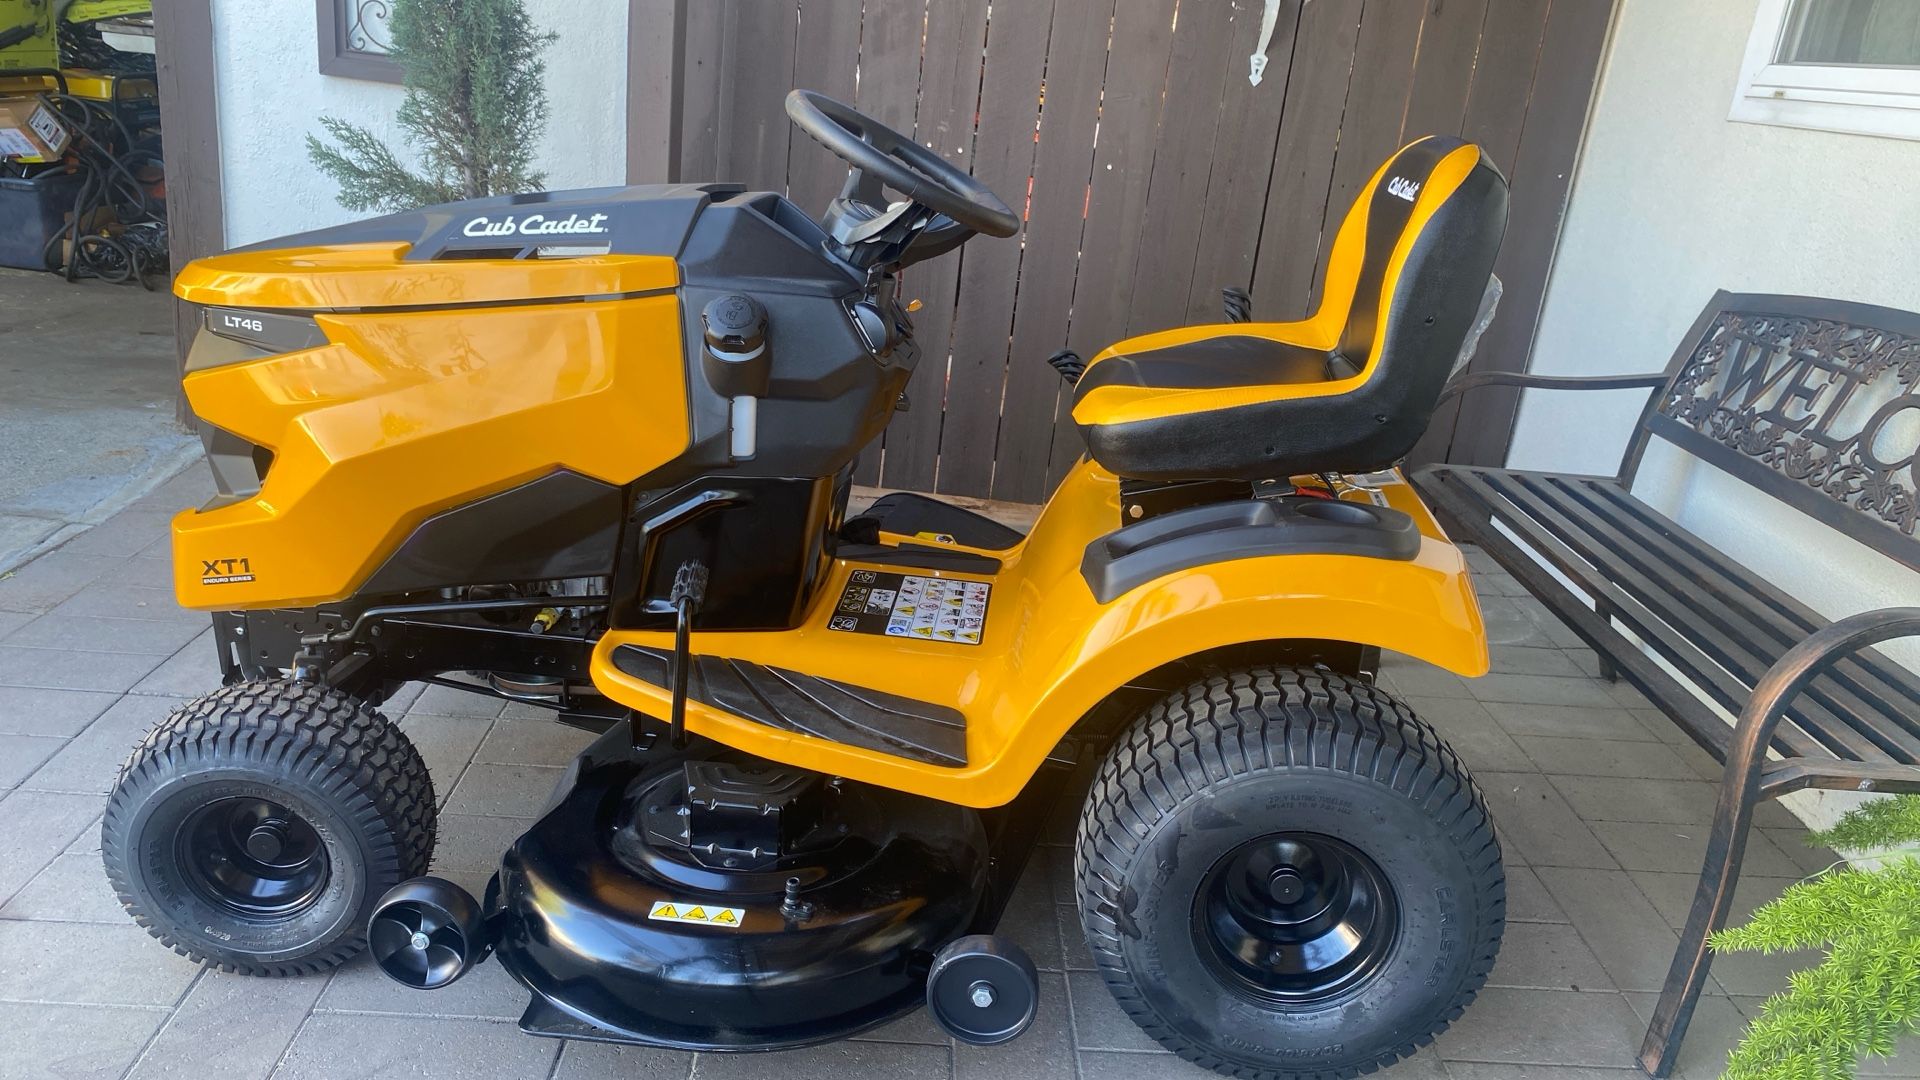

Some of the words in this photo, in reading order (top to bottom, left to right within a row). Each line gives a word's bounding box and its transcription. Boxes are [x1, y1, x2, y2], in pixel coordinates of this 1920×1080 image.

[463, 216, 517, 237] Cub
[519, 213, 609, 235] Cadet
[224, 315, 263, 332] LT46
[1716, 334, 1920, 494] WELC
[201, 558, 250, 575] XT1
